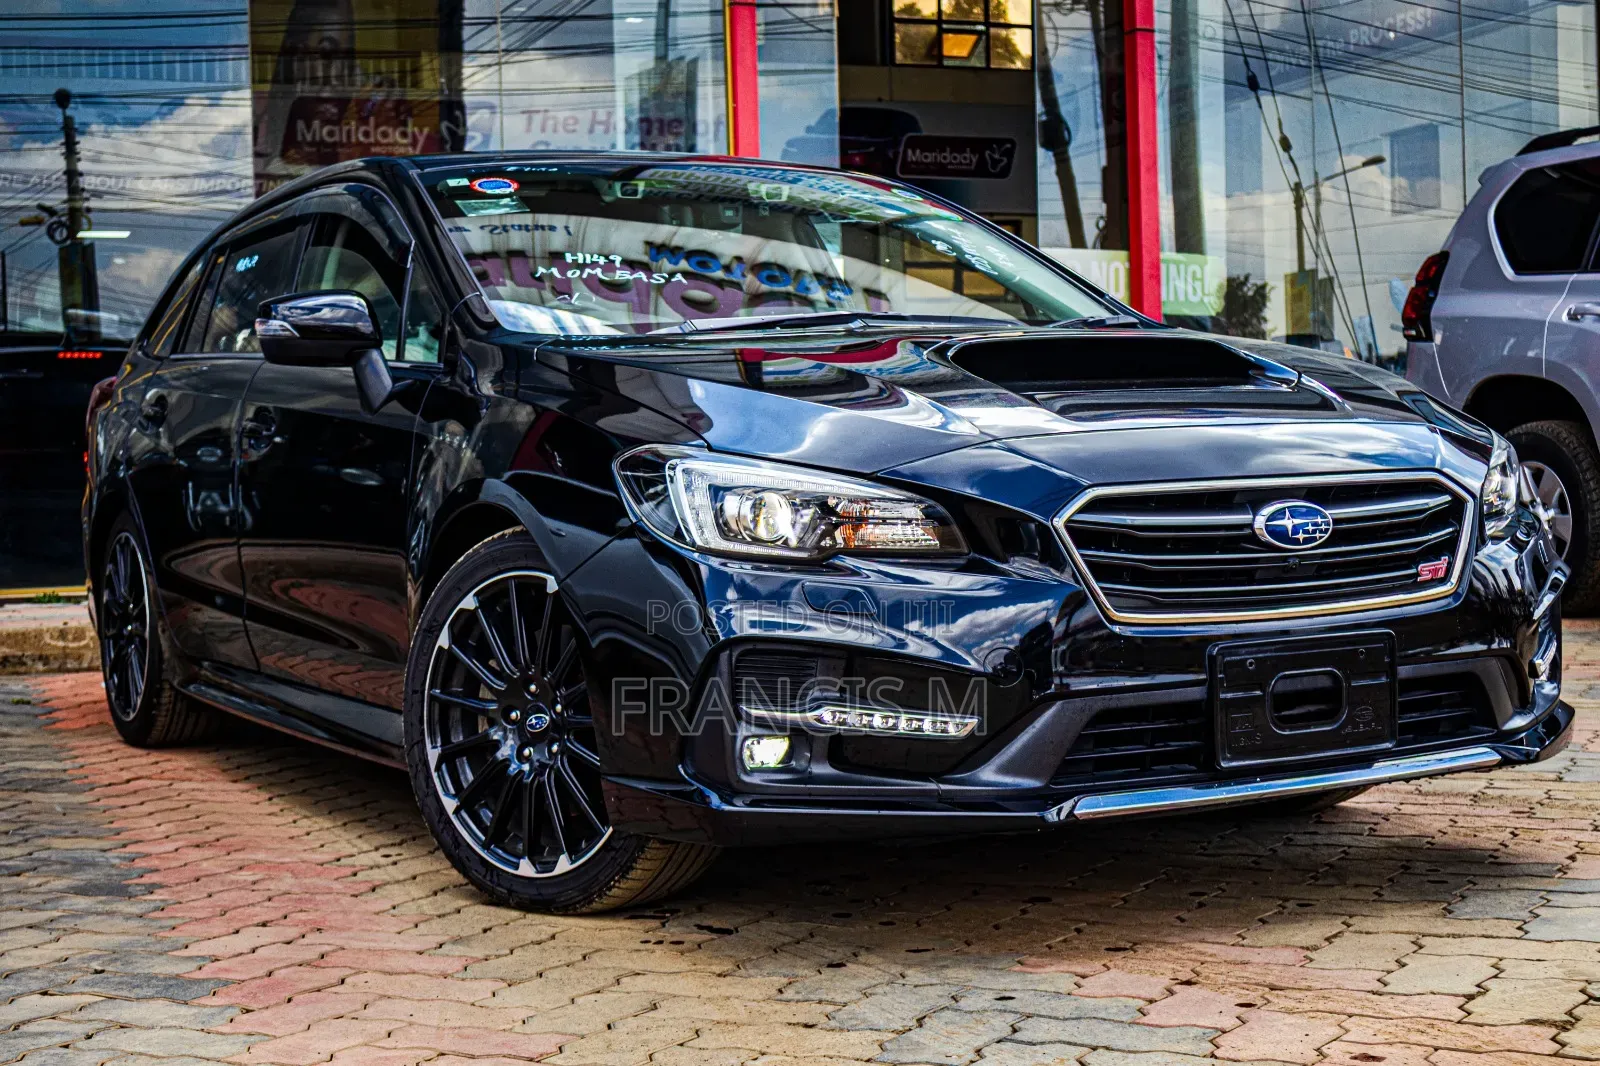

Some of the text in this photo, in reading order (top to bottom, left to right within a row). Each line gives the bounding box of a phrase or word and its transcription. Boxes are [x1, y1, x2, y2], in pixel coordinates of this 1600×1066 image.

[1349, 7, 1433, 51] PROCESS!
[296, 116, 429, 154] Maridady
[519, 109, 579, 134] The
[588, 110, 684, 137] Home
[907, 146, 979, 170] Maridady
